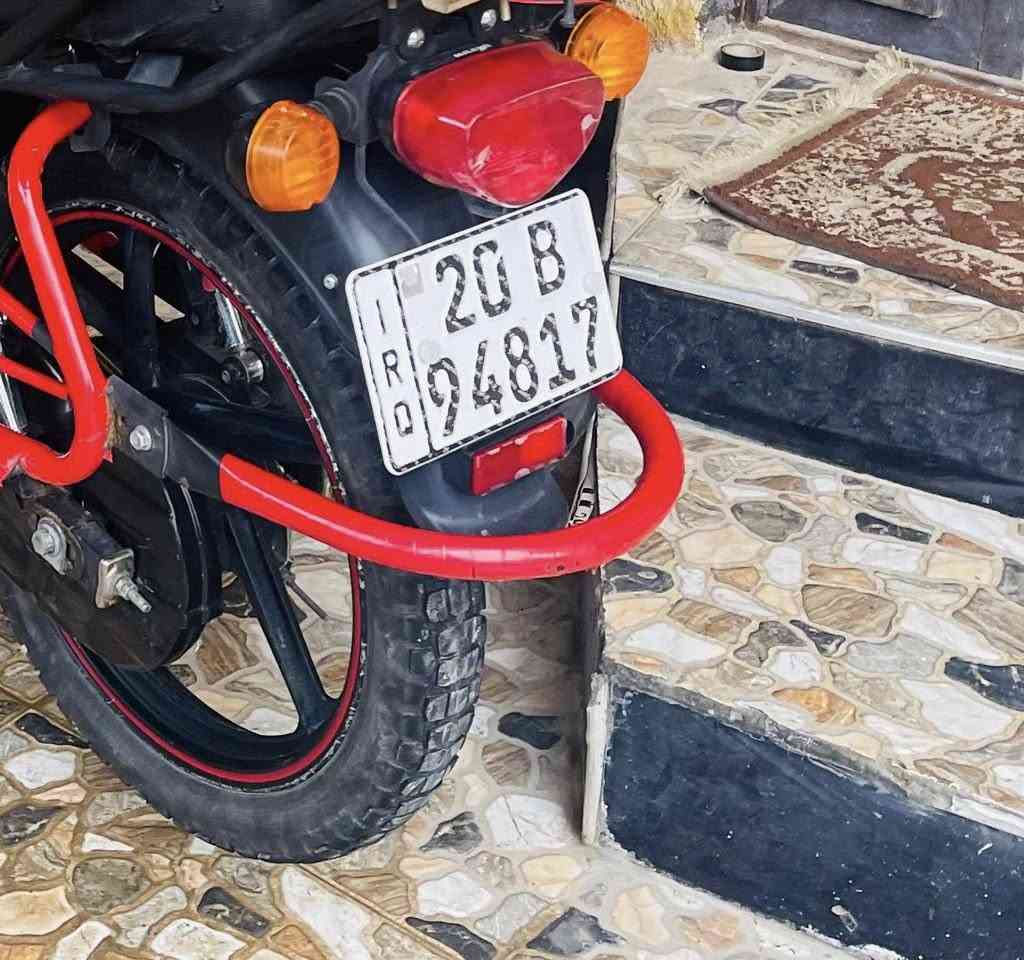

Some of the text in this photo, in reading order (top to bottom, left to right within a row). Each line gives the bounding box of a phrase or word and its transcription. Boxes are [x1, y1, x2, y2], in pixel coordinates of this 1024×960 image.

[435, 220, 566, 333] 20 B
[427, 295, 598, 437] 94817
